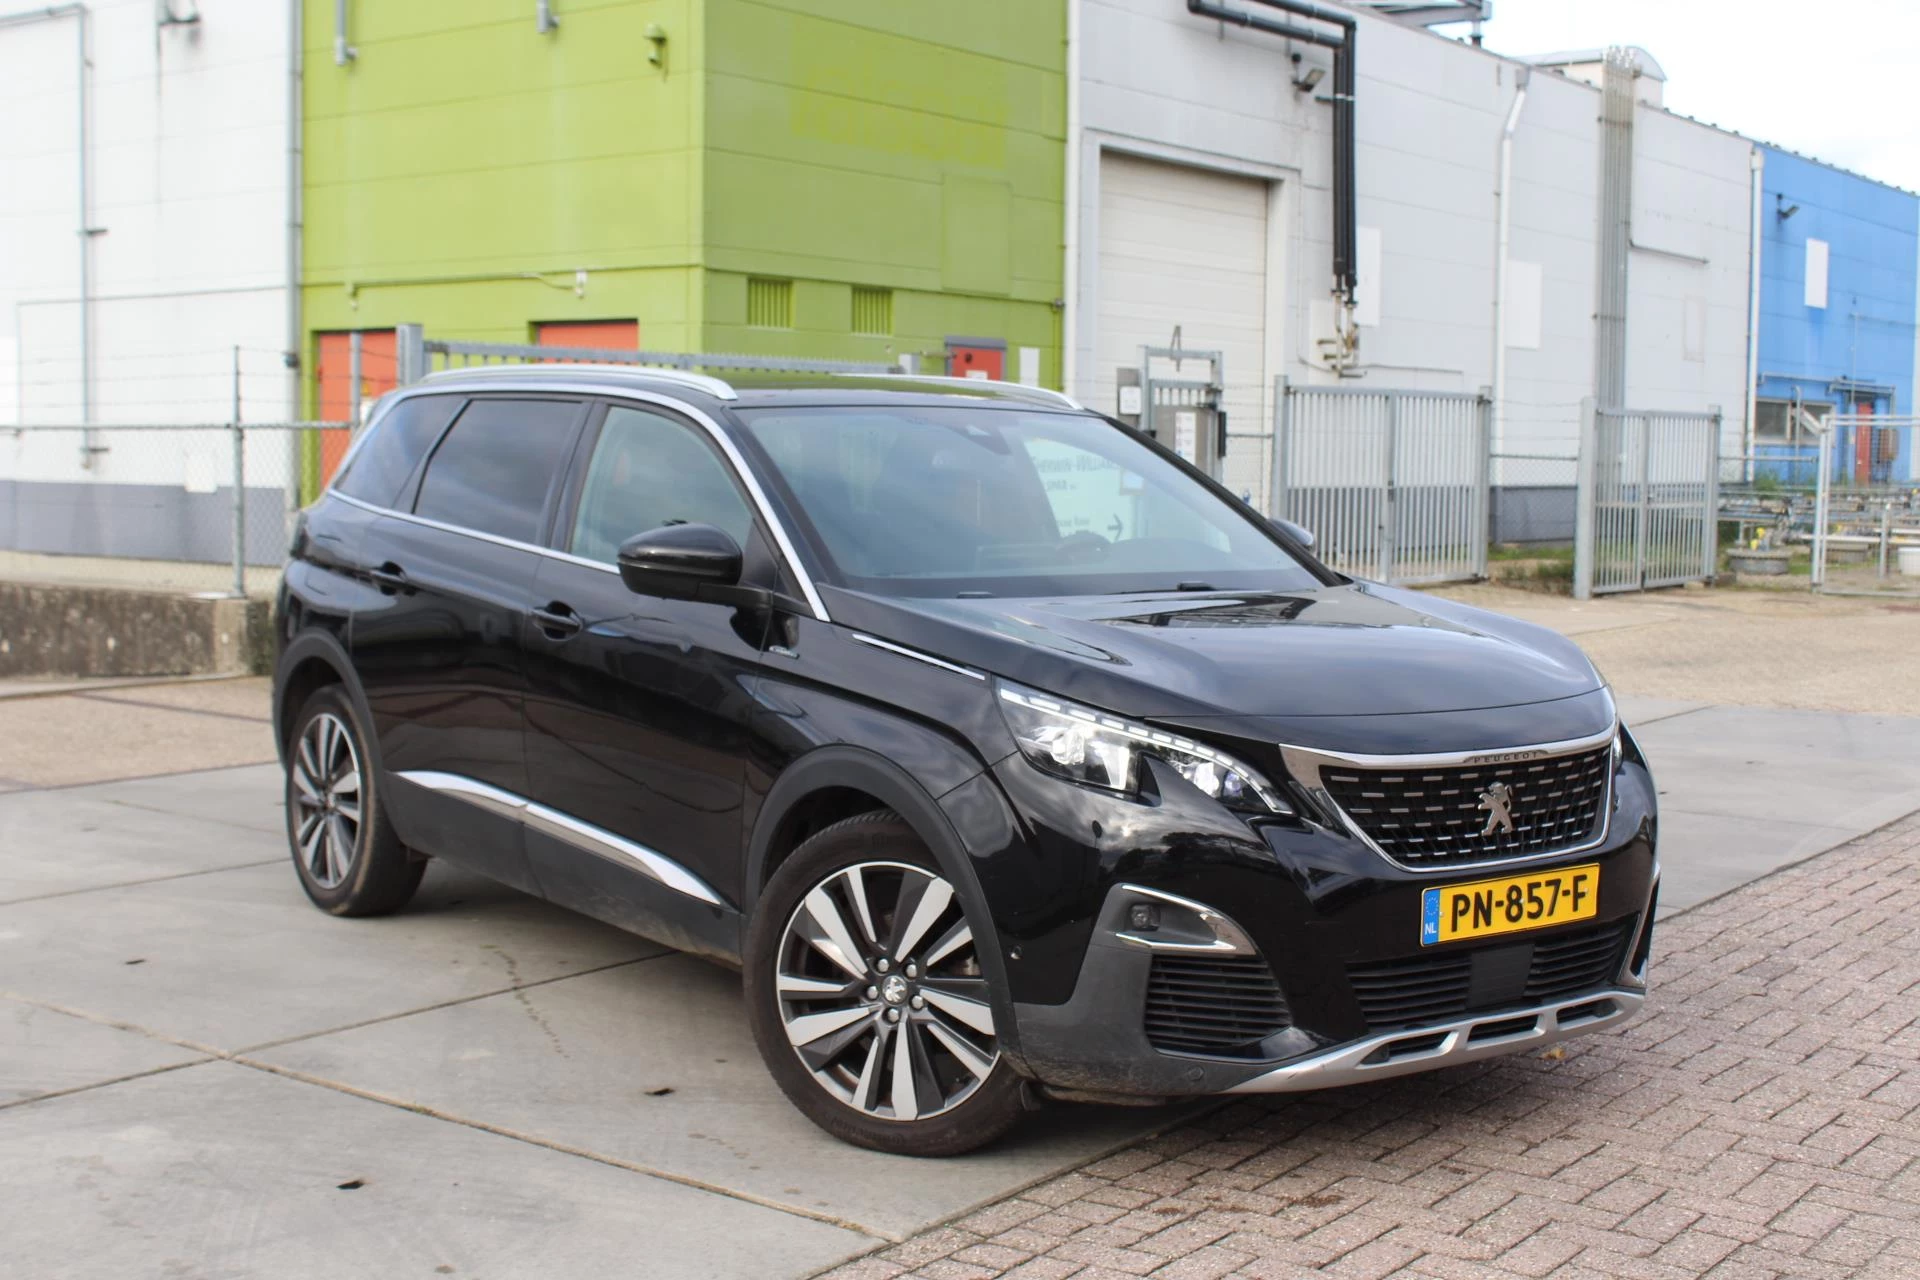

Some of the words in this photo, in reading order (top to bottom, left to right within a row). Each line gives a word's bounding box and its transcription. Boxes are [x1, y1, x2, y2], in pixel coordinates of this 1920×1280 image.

[1474, 751, 1538, 764] PEUGEOT
[1451, 874, 1588, 932] PN-857-F
[1424, 922, 1437, 936] NL
